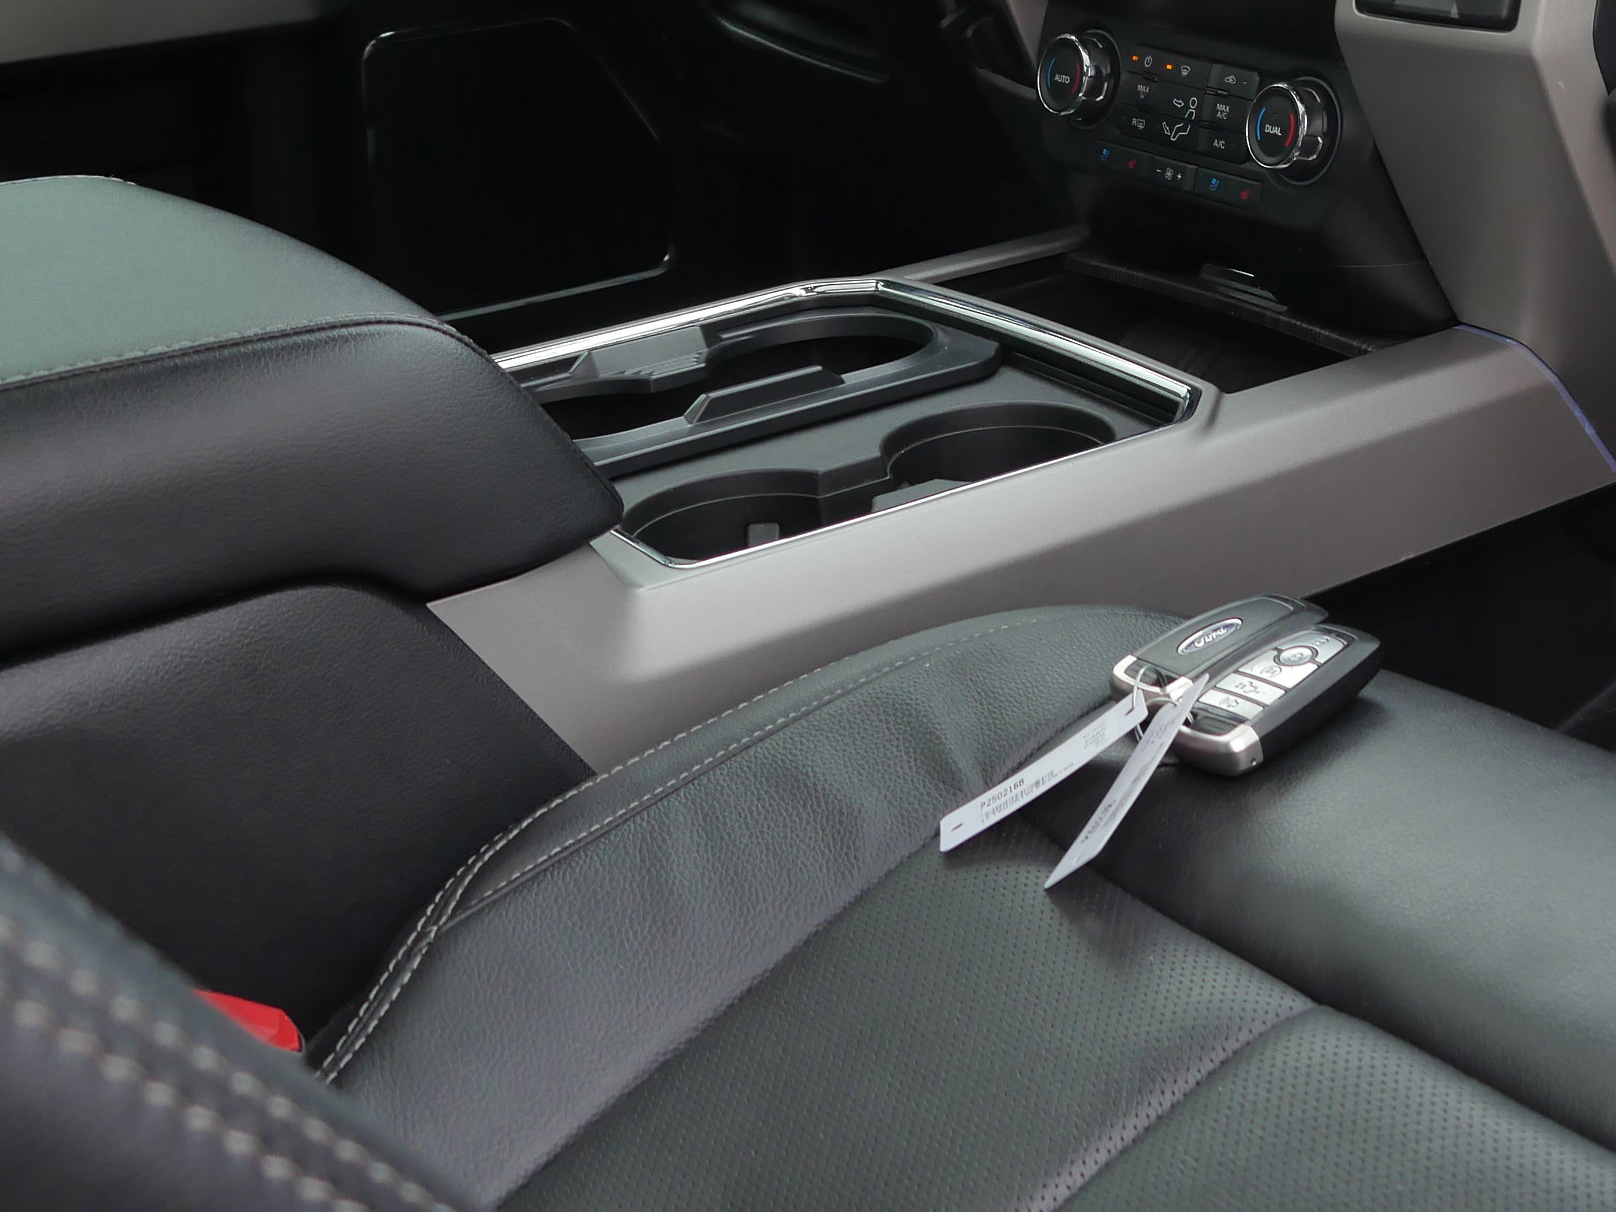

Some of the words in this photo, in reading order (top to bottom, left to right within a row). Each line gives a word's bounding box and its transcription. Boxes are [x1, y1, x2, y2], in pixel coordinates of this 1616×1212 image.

[1054, 73, 1070, 85] AUTO
[1216, 102, 1230, 114] MAX
[1216, 110, 1228, 121] A/C
[1264, 123, 1282, 137] DUAL
[1213, 138, 1226, 150] A/C
